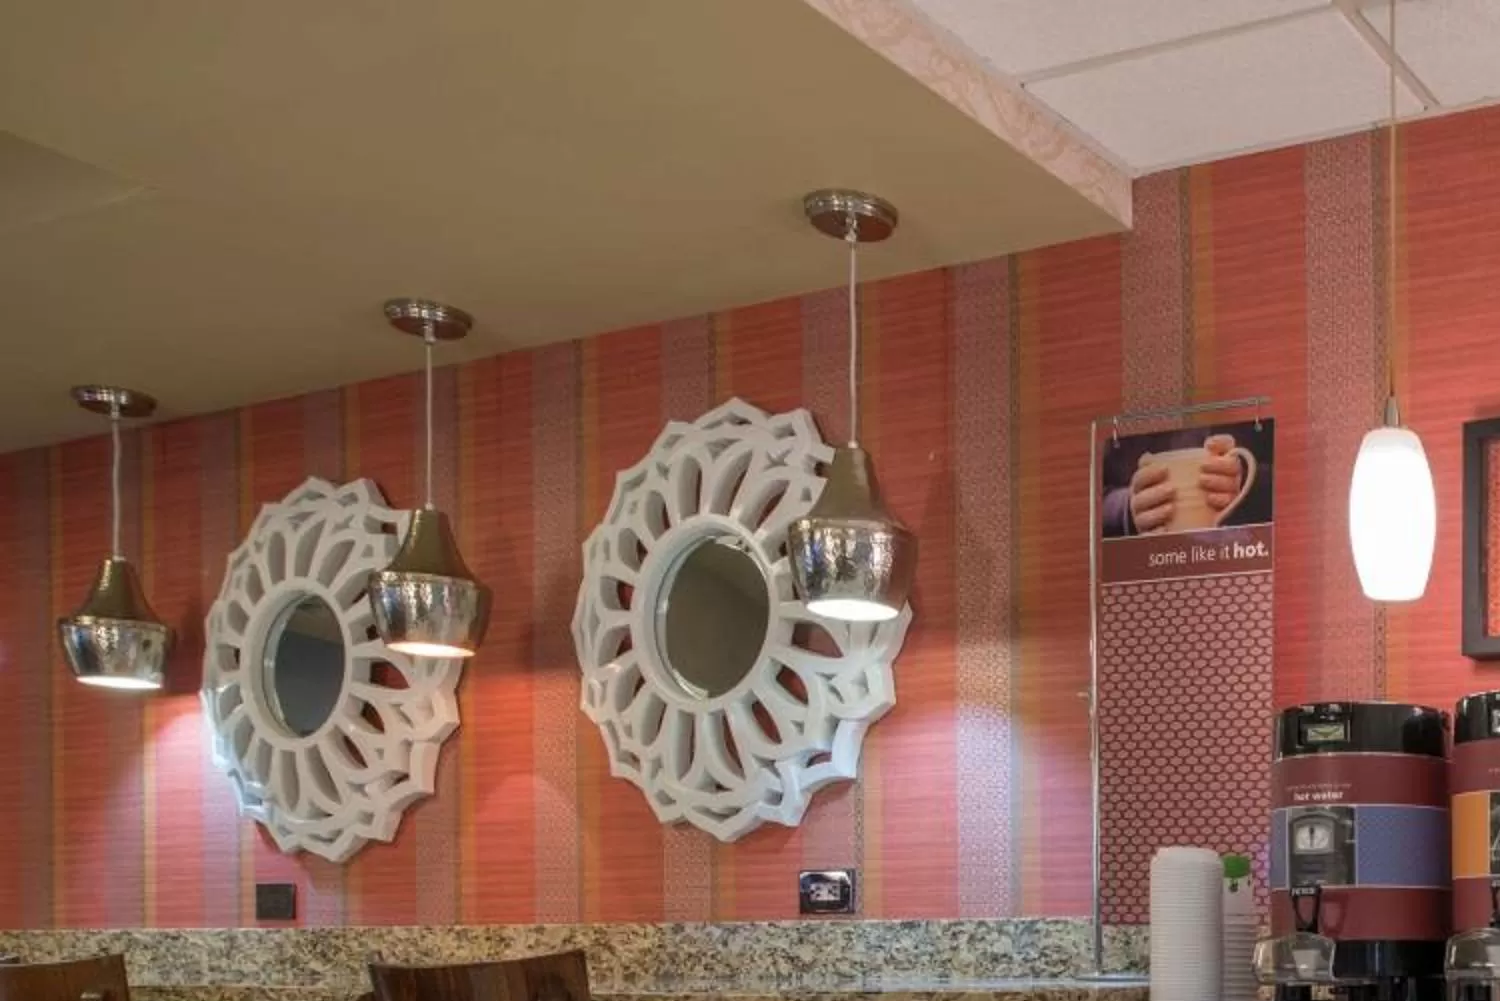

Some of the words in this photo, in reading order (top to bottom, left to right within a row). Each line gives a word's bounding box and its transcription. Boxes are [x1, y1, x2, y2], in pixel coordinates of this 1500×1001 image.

[1148, 550, 1187, 566] some
[1191, 545, 1217, 563] like
[1220, 544, 1230, 559] it
[1233, 541, 1269, 559] hot.
